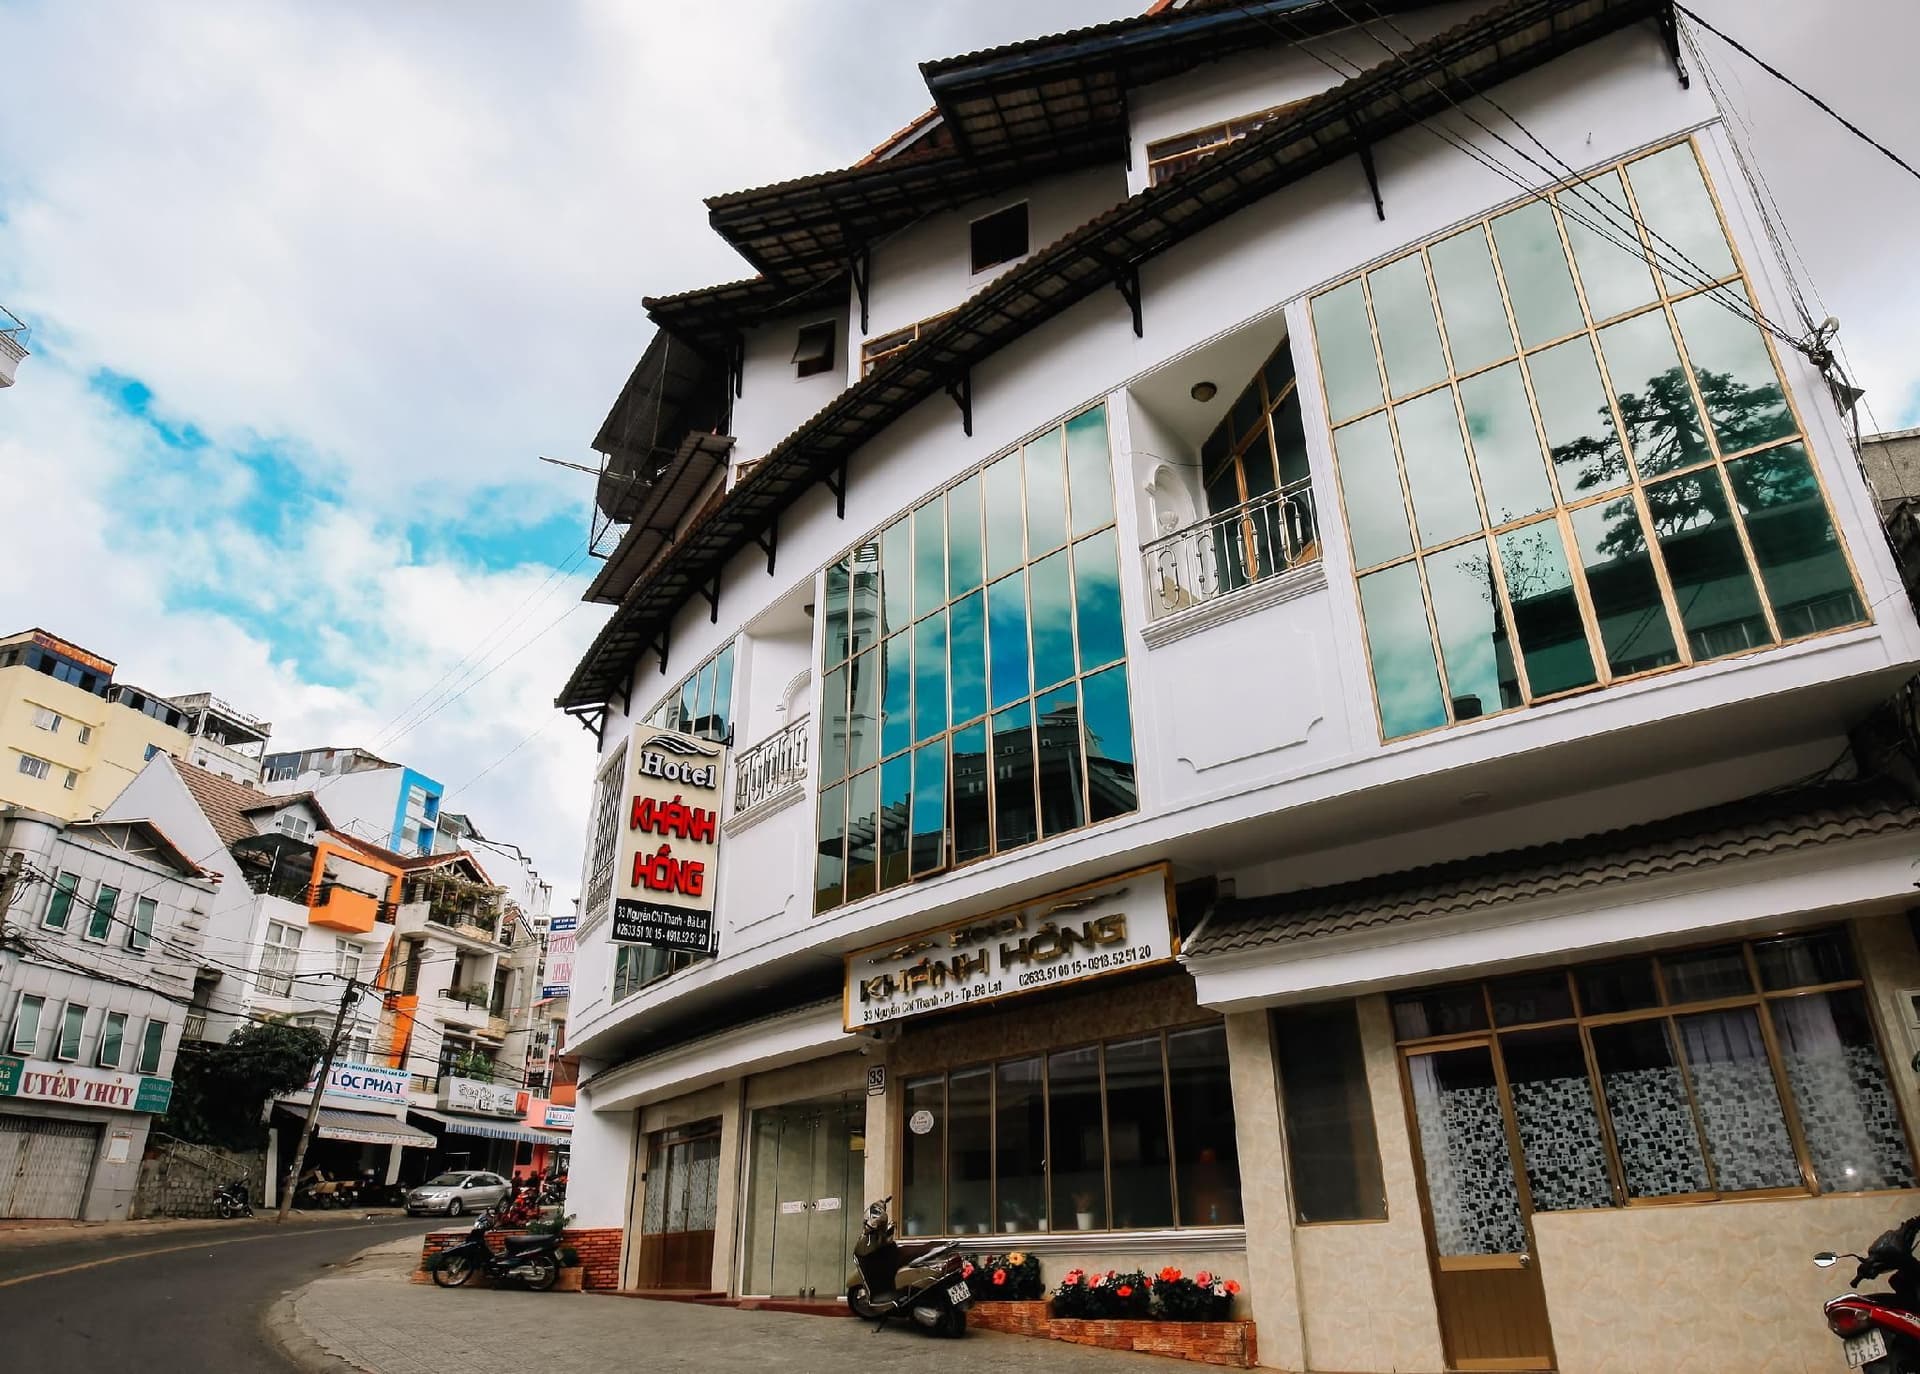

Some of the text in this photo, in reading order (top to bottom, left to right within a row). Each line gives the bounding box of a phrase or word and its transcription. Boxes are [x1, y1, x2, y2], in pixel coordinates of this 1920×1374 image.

[640, 751, 717, 789] Hotel
[630, 795, 717, 844] KHÁNH
[1139, 944, 1152, 960] 20
[859, 948, 990, 1004] KHÁNH
[863, 1010, 873, 1021] 33
[22, 1068, 80, 1100] UYÊN
[83, 1077, 134, 1106] THỦY
[869, 1070, 884, 1084] 33
